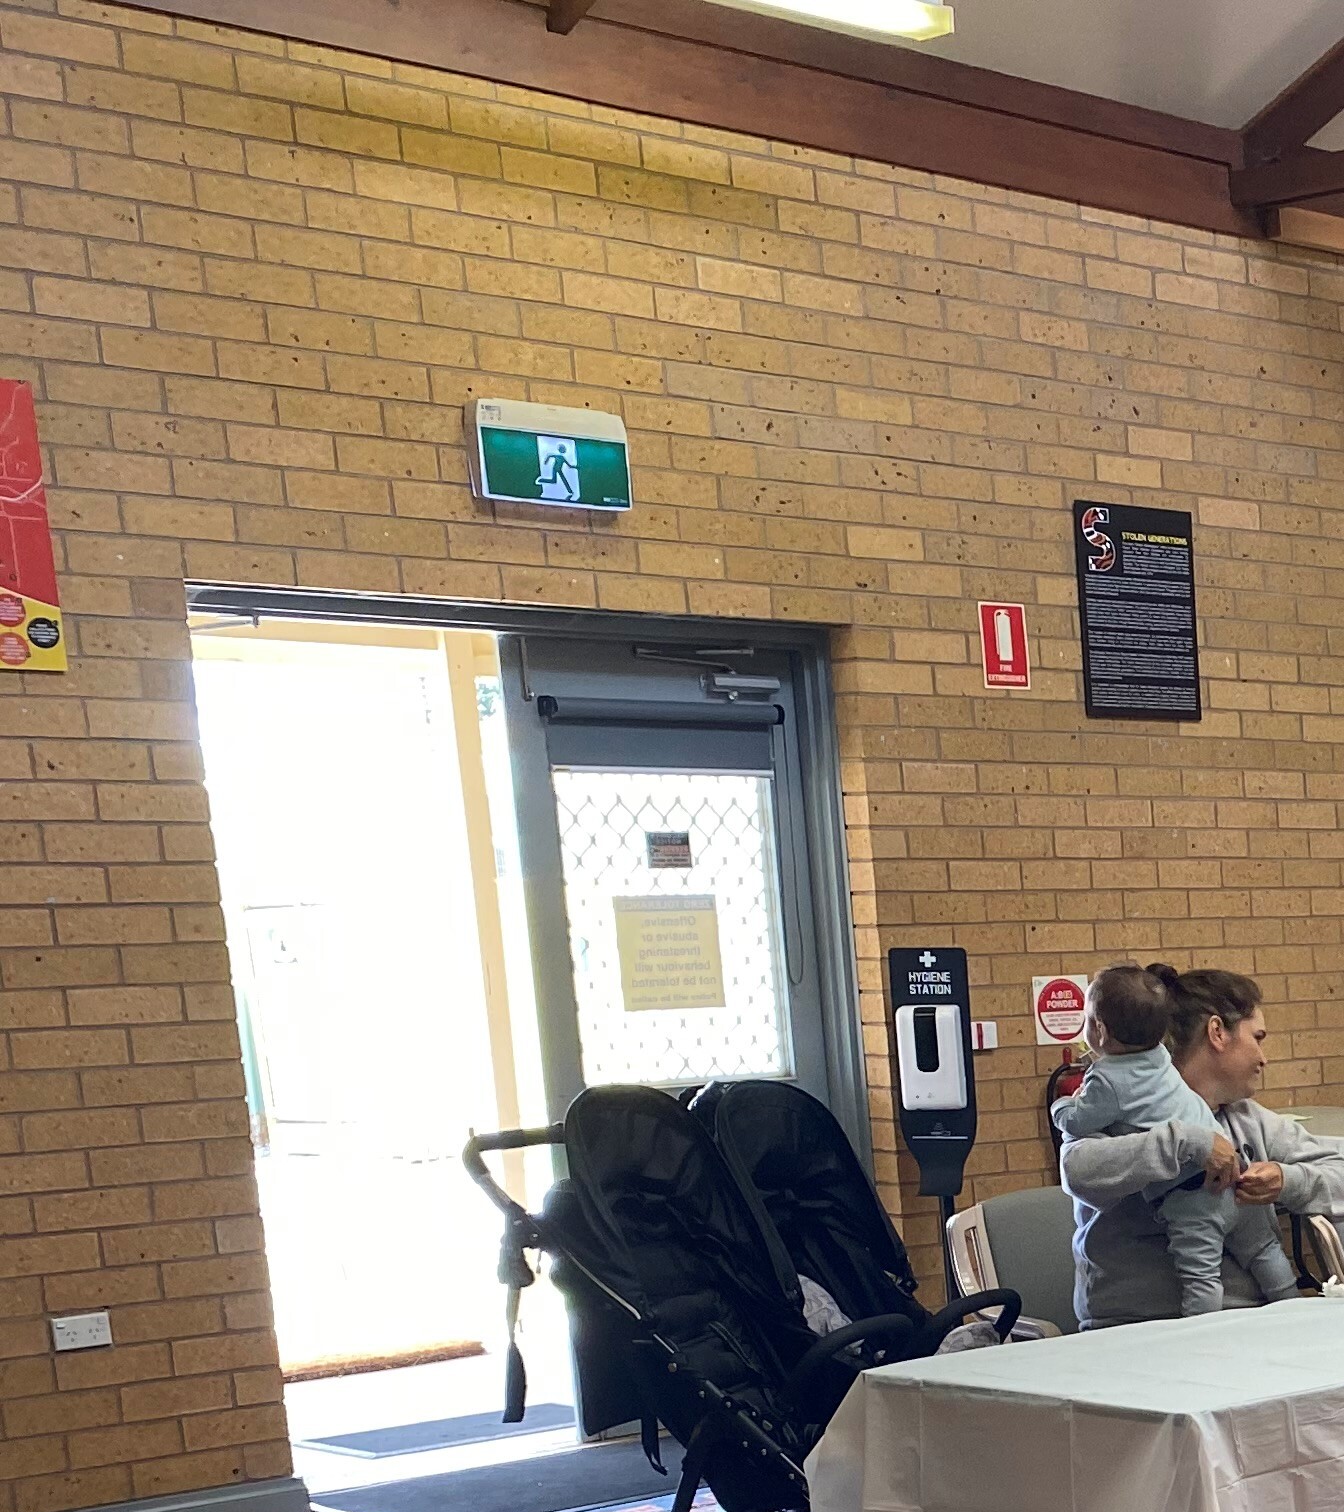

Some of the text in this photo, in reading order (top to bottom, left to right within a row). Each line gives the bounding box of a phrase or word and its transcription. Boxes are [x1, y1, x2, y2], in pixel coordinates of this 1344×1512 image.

[1082, 507, 1116, 571] S
[1122, 531, 1188, 545] STOLEN GENERATIONS
[908, 971, 951, 983] HYGIENE
[909, 984, 952, 995] STATION
[1046, 1000, 1079, 1009] POWDER
